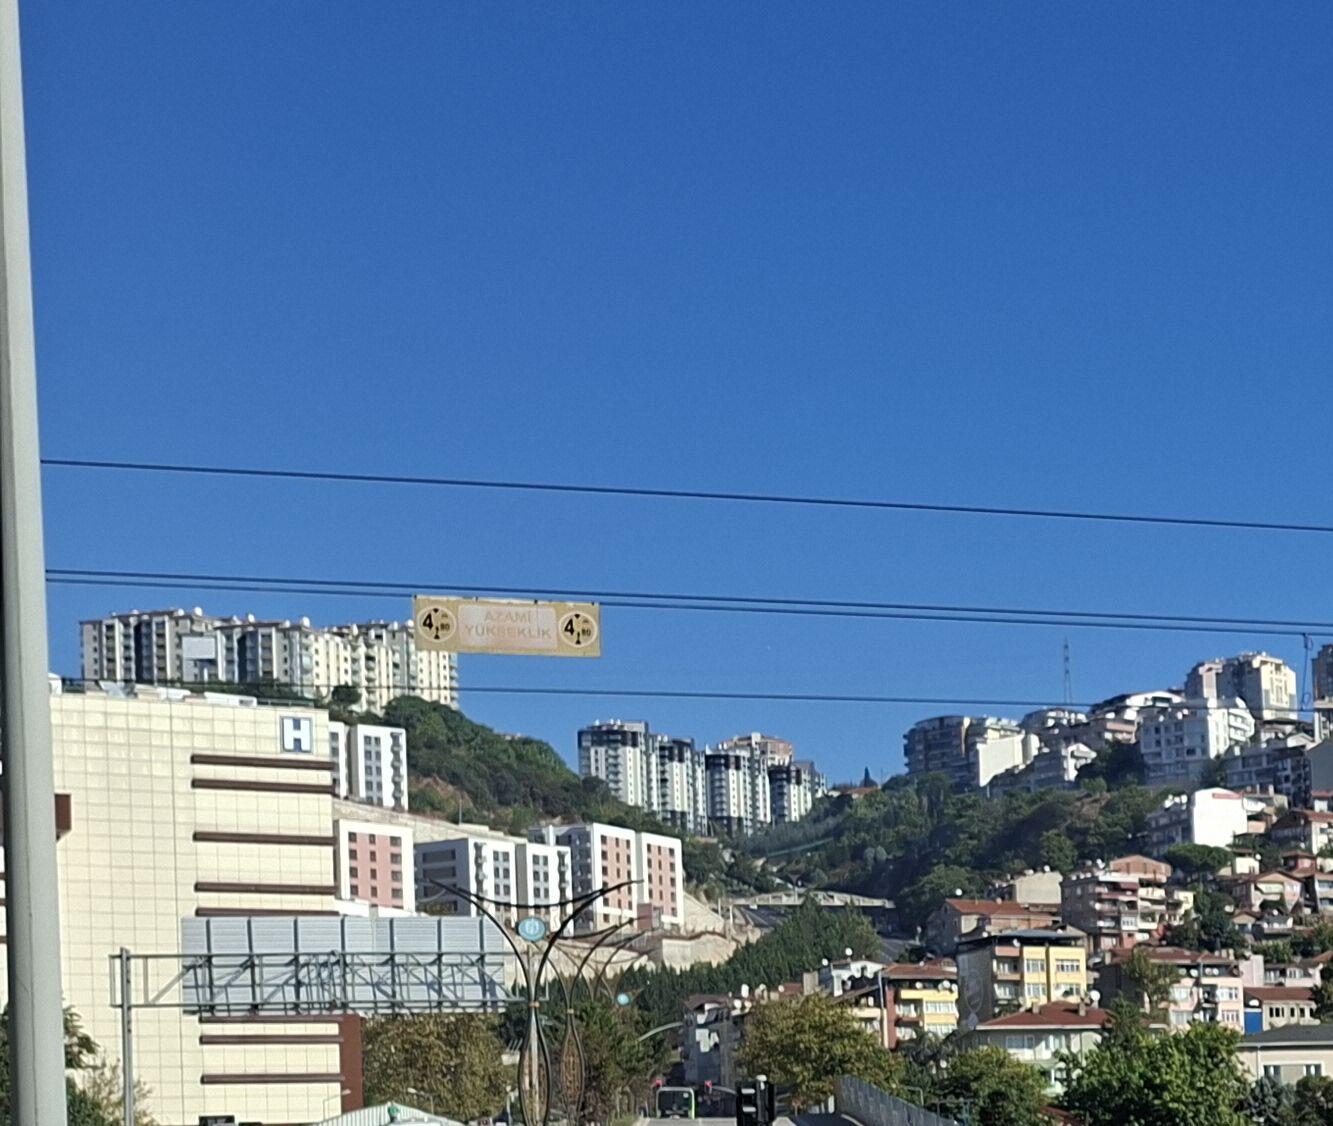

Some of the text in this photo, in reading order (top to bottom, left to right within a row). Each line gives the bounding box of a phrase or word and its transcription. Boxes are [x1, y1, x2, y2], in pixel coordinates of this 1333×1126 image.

[422, 613, 434, 630] 4
[564, 618, 575, 636] 4
[283, 718, 311, 751] H
